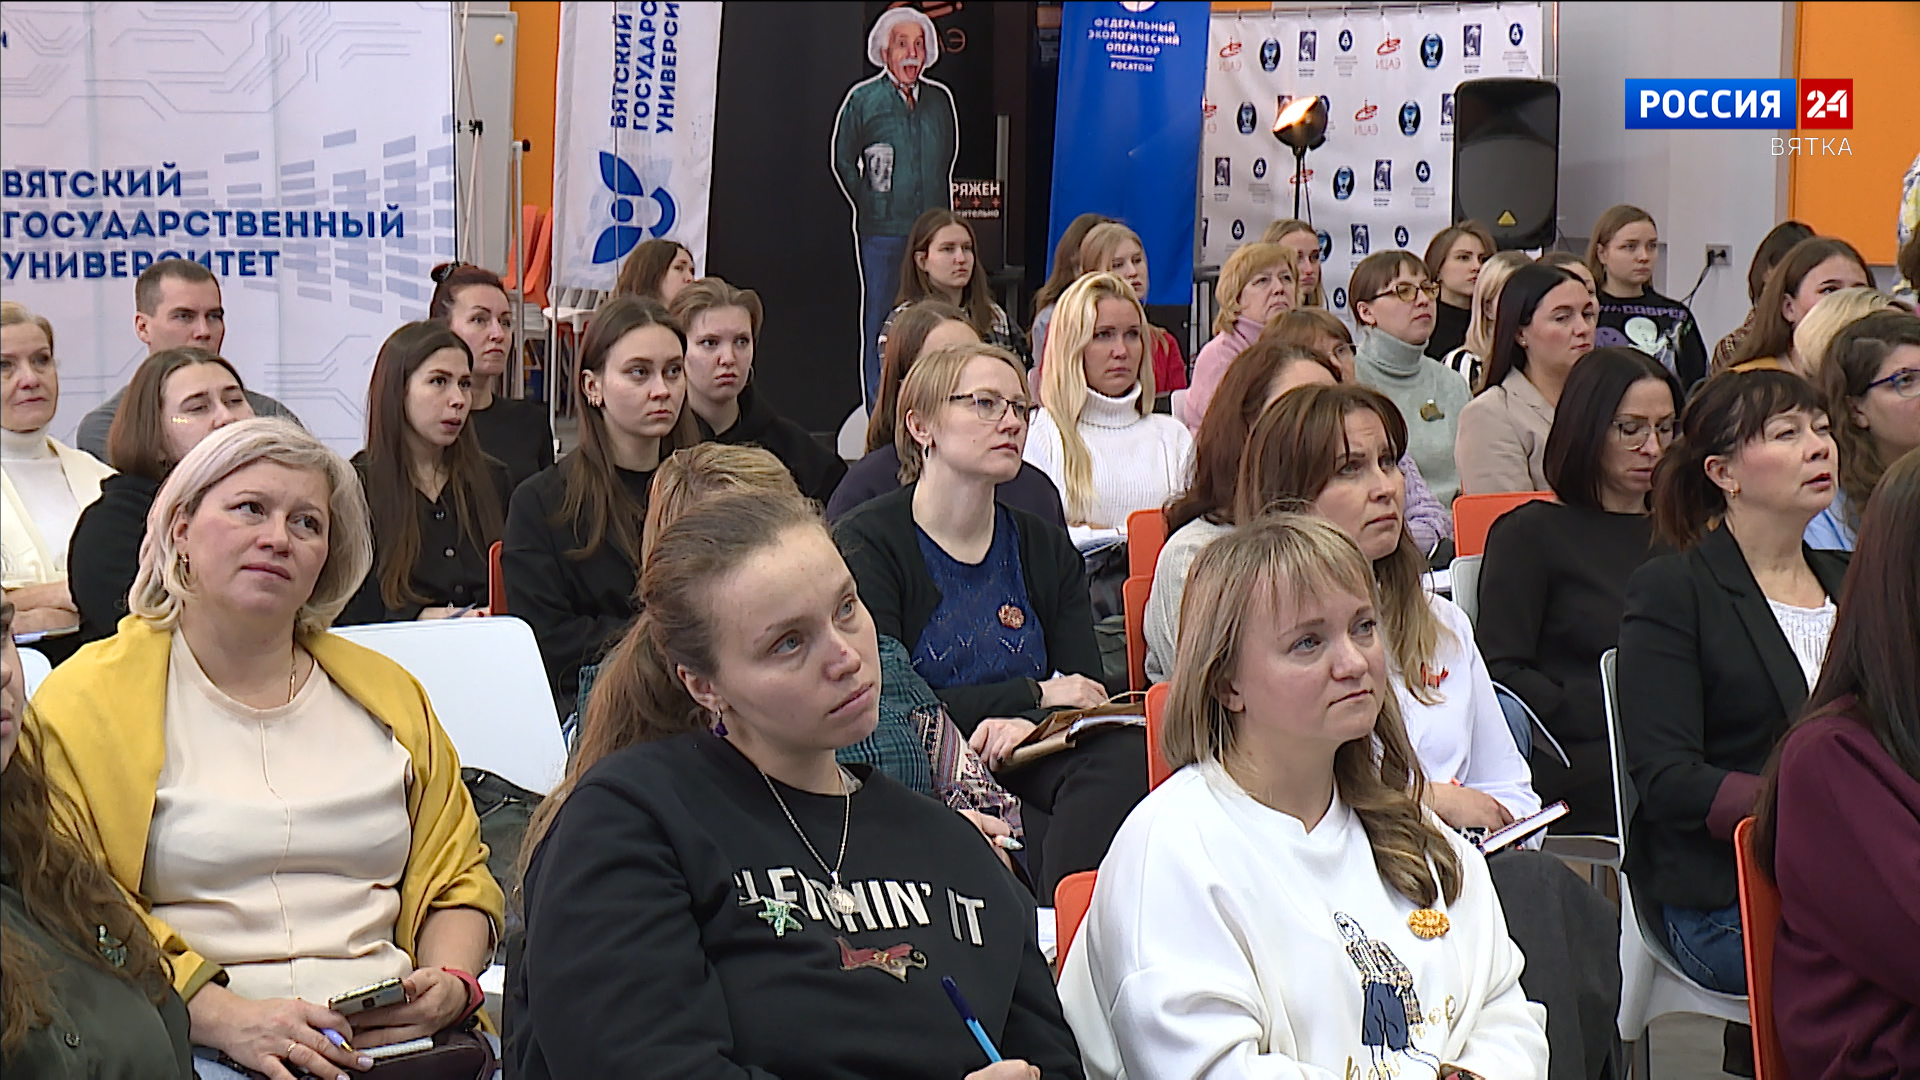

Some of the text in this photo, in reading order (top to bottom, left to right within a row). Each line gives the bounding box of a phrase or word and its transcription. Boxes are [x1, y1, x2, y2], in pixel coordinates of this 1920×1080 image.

[1087, 29, 1180, 46] ЭКОЛОГИЧЕСКИЙ
[1093, 18, 1176, 33] ФЕДЕРАЛЬНЫЙ
[1105, 42, 1161, 55] ОПЕРАТОР
[610, 13, 633, 129] ВЯТСКИЙ
[1110, 61, 1154, 72] РОСАТОМ
[2, 161, 182, 198] ВЯТСКИЙ
[2, 203, 404, 240] ГОСУДАРСТВЕННЫЙ
[946, 887, 985, 946] IT
